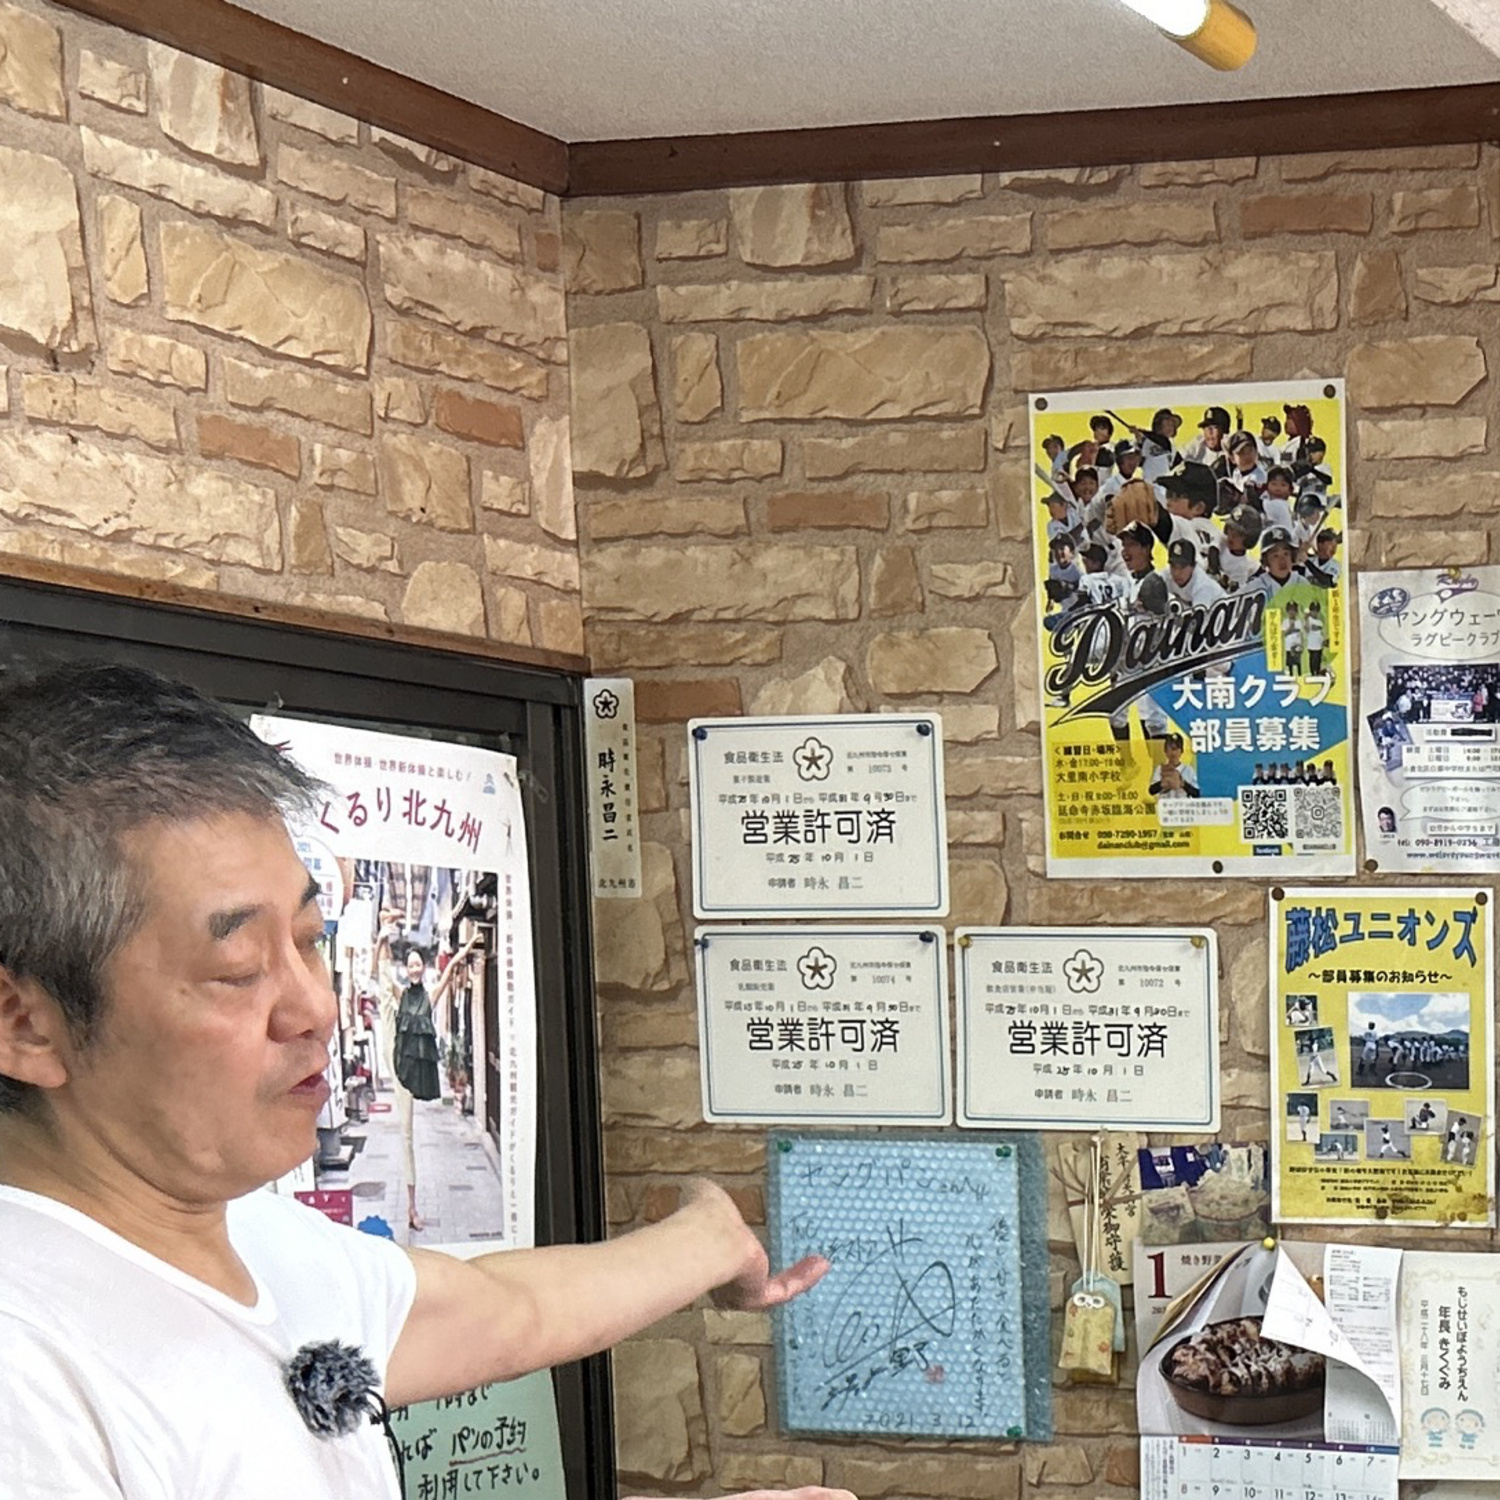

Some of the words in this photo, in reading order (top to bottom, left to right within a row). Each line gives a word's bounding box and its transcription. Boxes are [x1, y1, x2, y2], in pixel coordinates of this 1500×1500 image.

[1044, 587, 1268, 694] Dainan
[1411, 630, 1500, 647] ラグビークラブ
[1173, 672, 1334, 710] 大南クラブ
[1189, 717, 1321, 752] 部員募集
[724, 751, 784, 764] 食品衛生法
[598, 748, 618, 841] 時永昌二
[741, 808, 896, 844] 営業許可済
[1285, 906, 1478, 973] 藤松ユニオンズ
[730, 958, 787, 972] 食品衛生法
[992, 961, 1053, 974] 食品衛生法
[746, 1017, 899, 1053] 営業許可済
[1008, 1020, 1168, 1058] 営業許可済
[1147, 1252, 1173, 1298] 1
[1438, 1305, 1451, 1334] 年長
[1456, 1286, 1468, 1402] もじせいぼようちえん
[451, 1416, 526, 1456] パンの予約
[1181, 1446, 1187, 1457] 1
[1213, 1448, 1220, 1458] 2
[1244, 1449, 1251, 1460] 3
[1274, 1451, 1281, 1462] 4
[1305, 1453, 1312, 1464] 5
[1336, 1456, 1343, 1465] 6
[1367, 1456, 1374, 1466] 7
[1181, 1484, 1188, 1494] 8
[1212, 1485, 1219, 1496] 9
[1244, 1487, 1256, 1498] 10
[1274, 1489, 1284, 1500] 11
